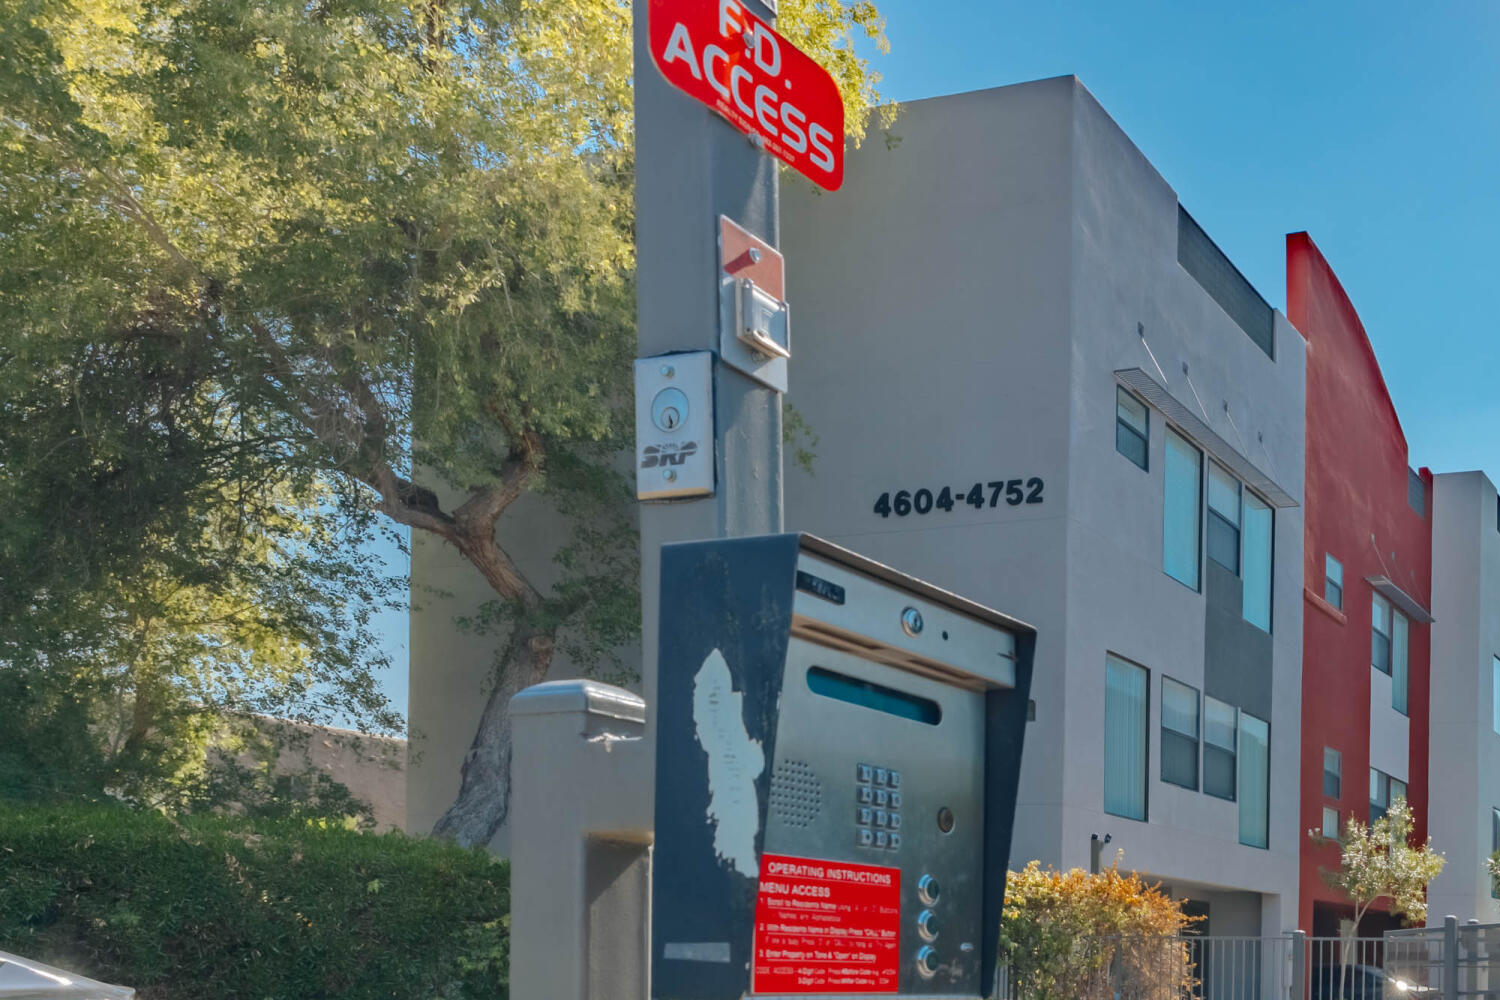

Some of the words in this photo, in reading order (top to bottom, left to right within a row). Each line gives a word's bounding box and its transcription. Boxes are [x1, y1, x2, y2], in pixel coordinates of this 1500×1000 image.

[663, 22, 835, 173] ACCESS
[873, 477, 1044, 518] 4604-4752
[768, 862, 824, 878] OPERATING
[827, 869, 891, 884] INSTRUCTIONS
[760, 882, 789, 893] MENU
[792, 885, 830, 897] ACCESS
